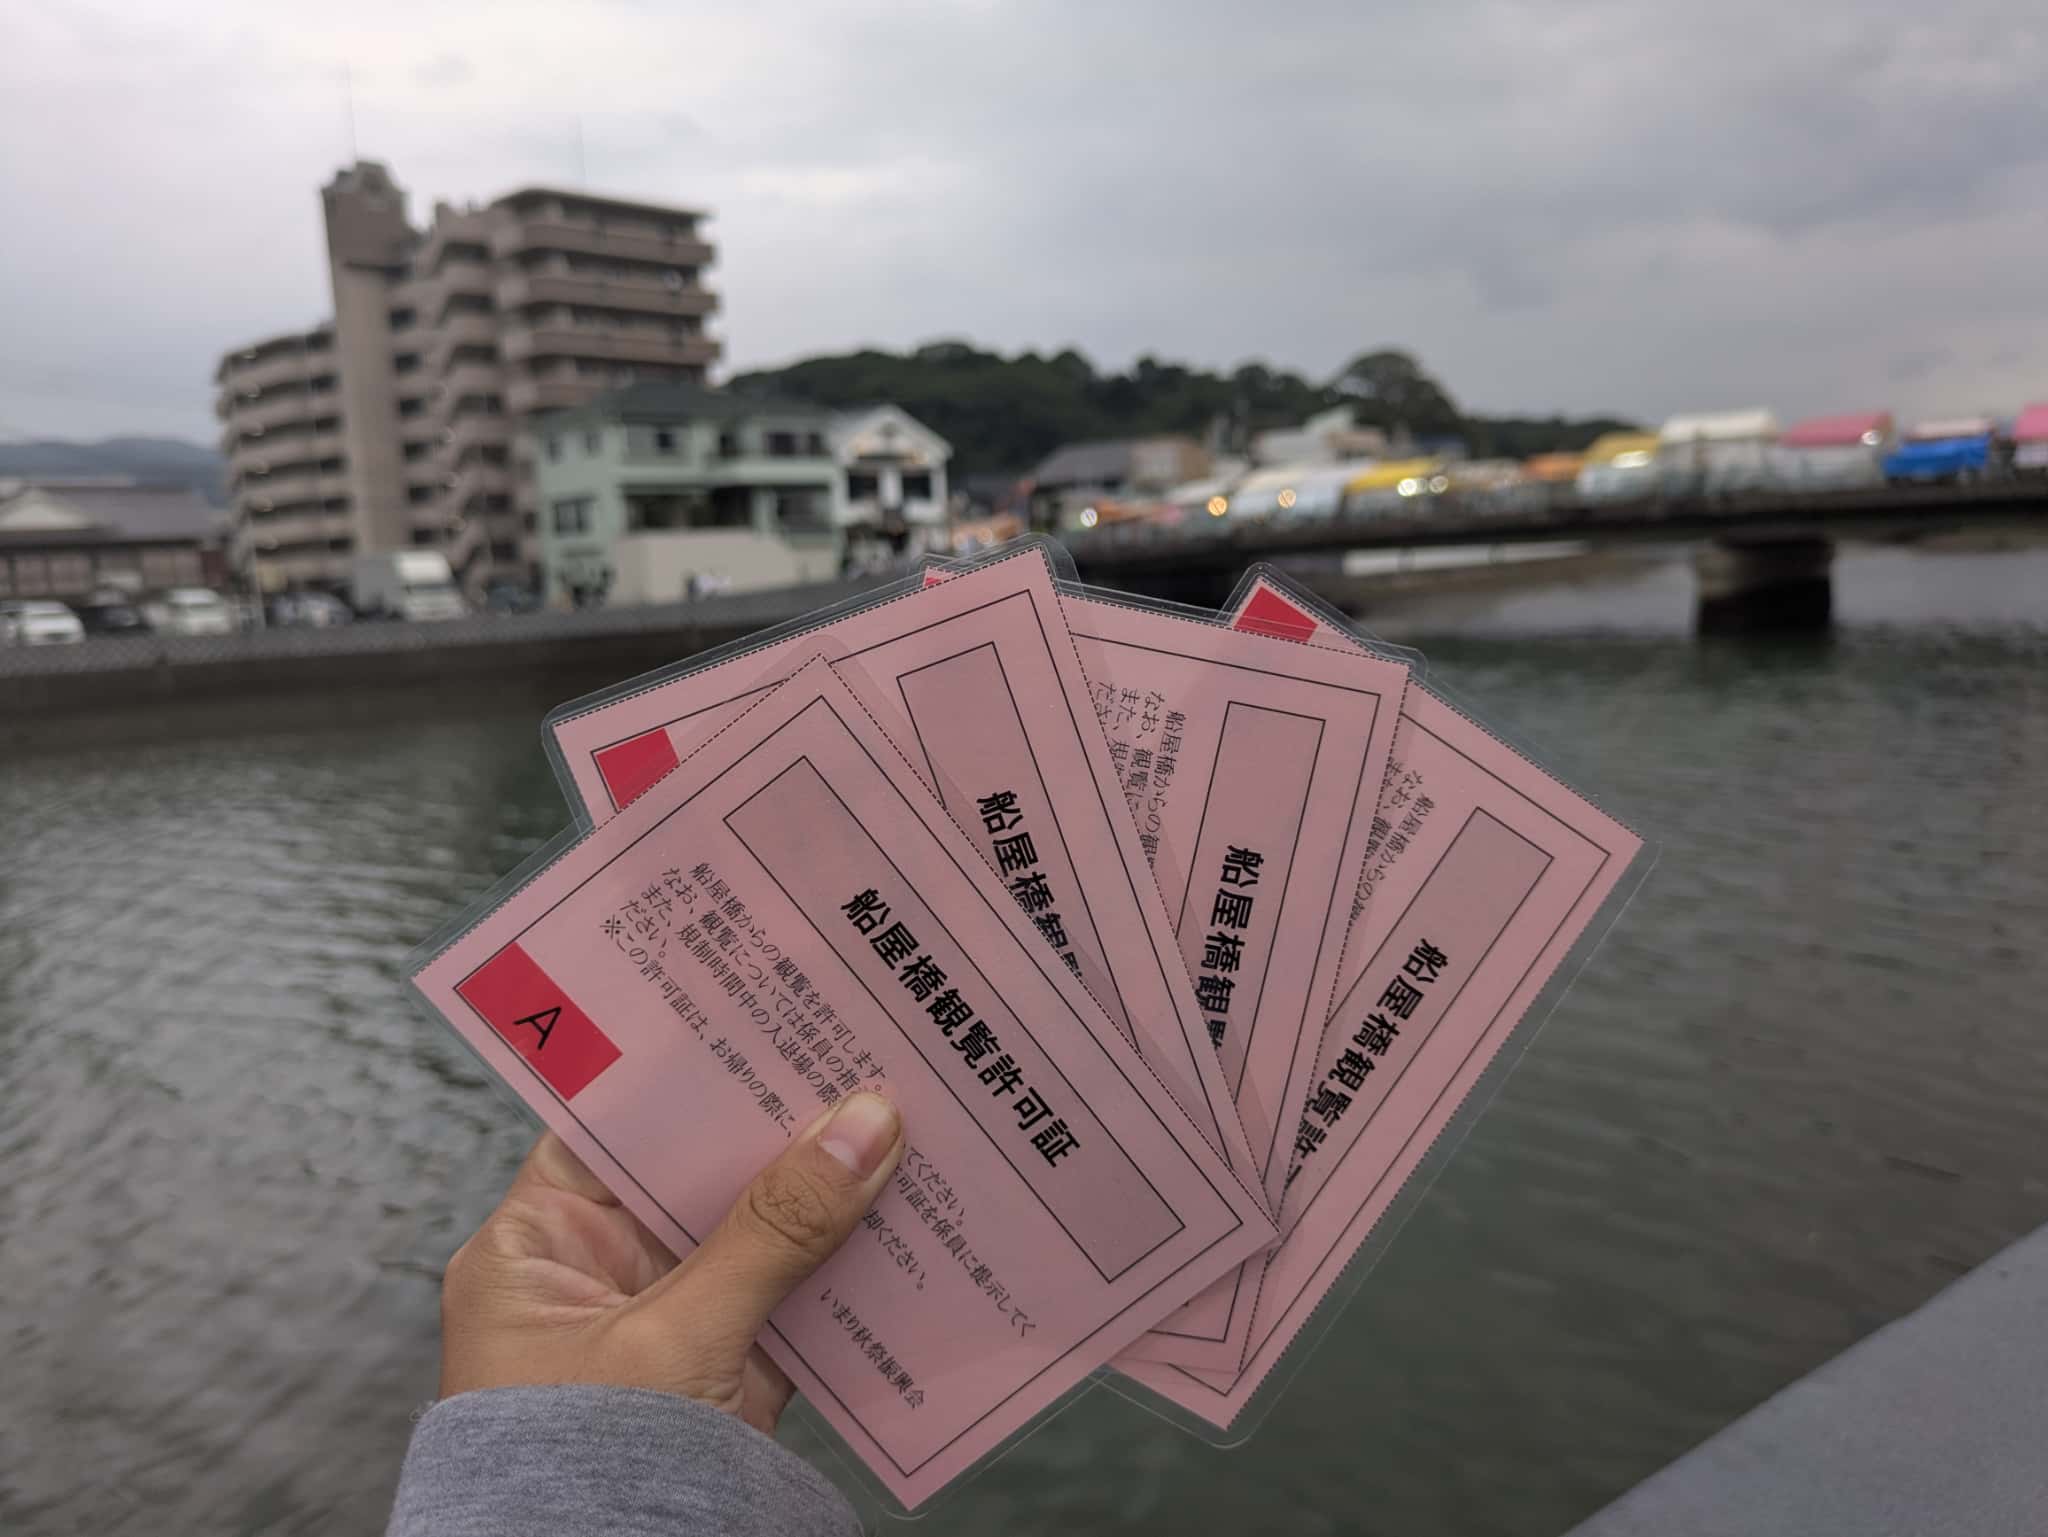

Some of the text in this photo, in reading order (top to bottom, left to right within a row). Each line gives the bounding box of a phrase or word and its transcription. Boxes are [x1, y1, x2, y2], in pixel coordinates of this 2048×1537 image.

[1093, 681, 1117, 728] ださ
[1139, 710, 1187, 872] 船屋橋からの観
[619, 900, 681, 962] ださい。
[688, 862, 886, 1096] 船屋橋からの観覧を許可します。
[976, 787, 1083, 978] 船屋橋観
[513, 1006, 562, 1051] A
[640, 882, 842, 1109] また、規制時間中の入退場の際
[660, 867, 965, 1227] なお、観覧については係員の指 てください。
[840, 888, 1080, 1168] 船屋橋観覧許可証
[1286, 938, 1448, 1187] 船屋橋観覧許
[600, 914, 925, 1290] ※この許可証は、お帰りの際に、 却ください。
[820, 1288, 925, 1410] いまり秋祭振興会
